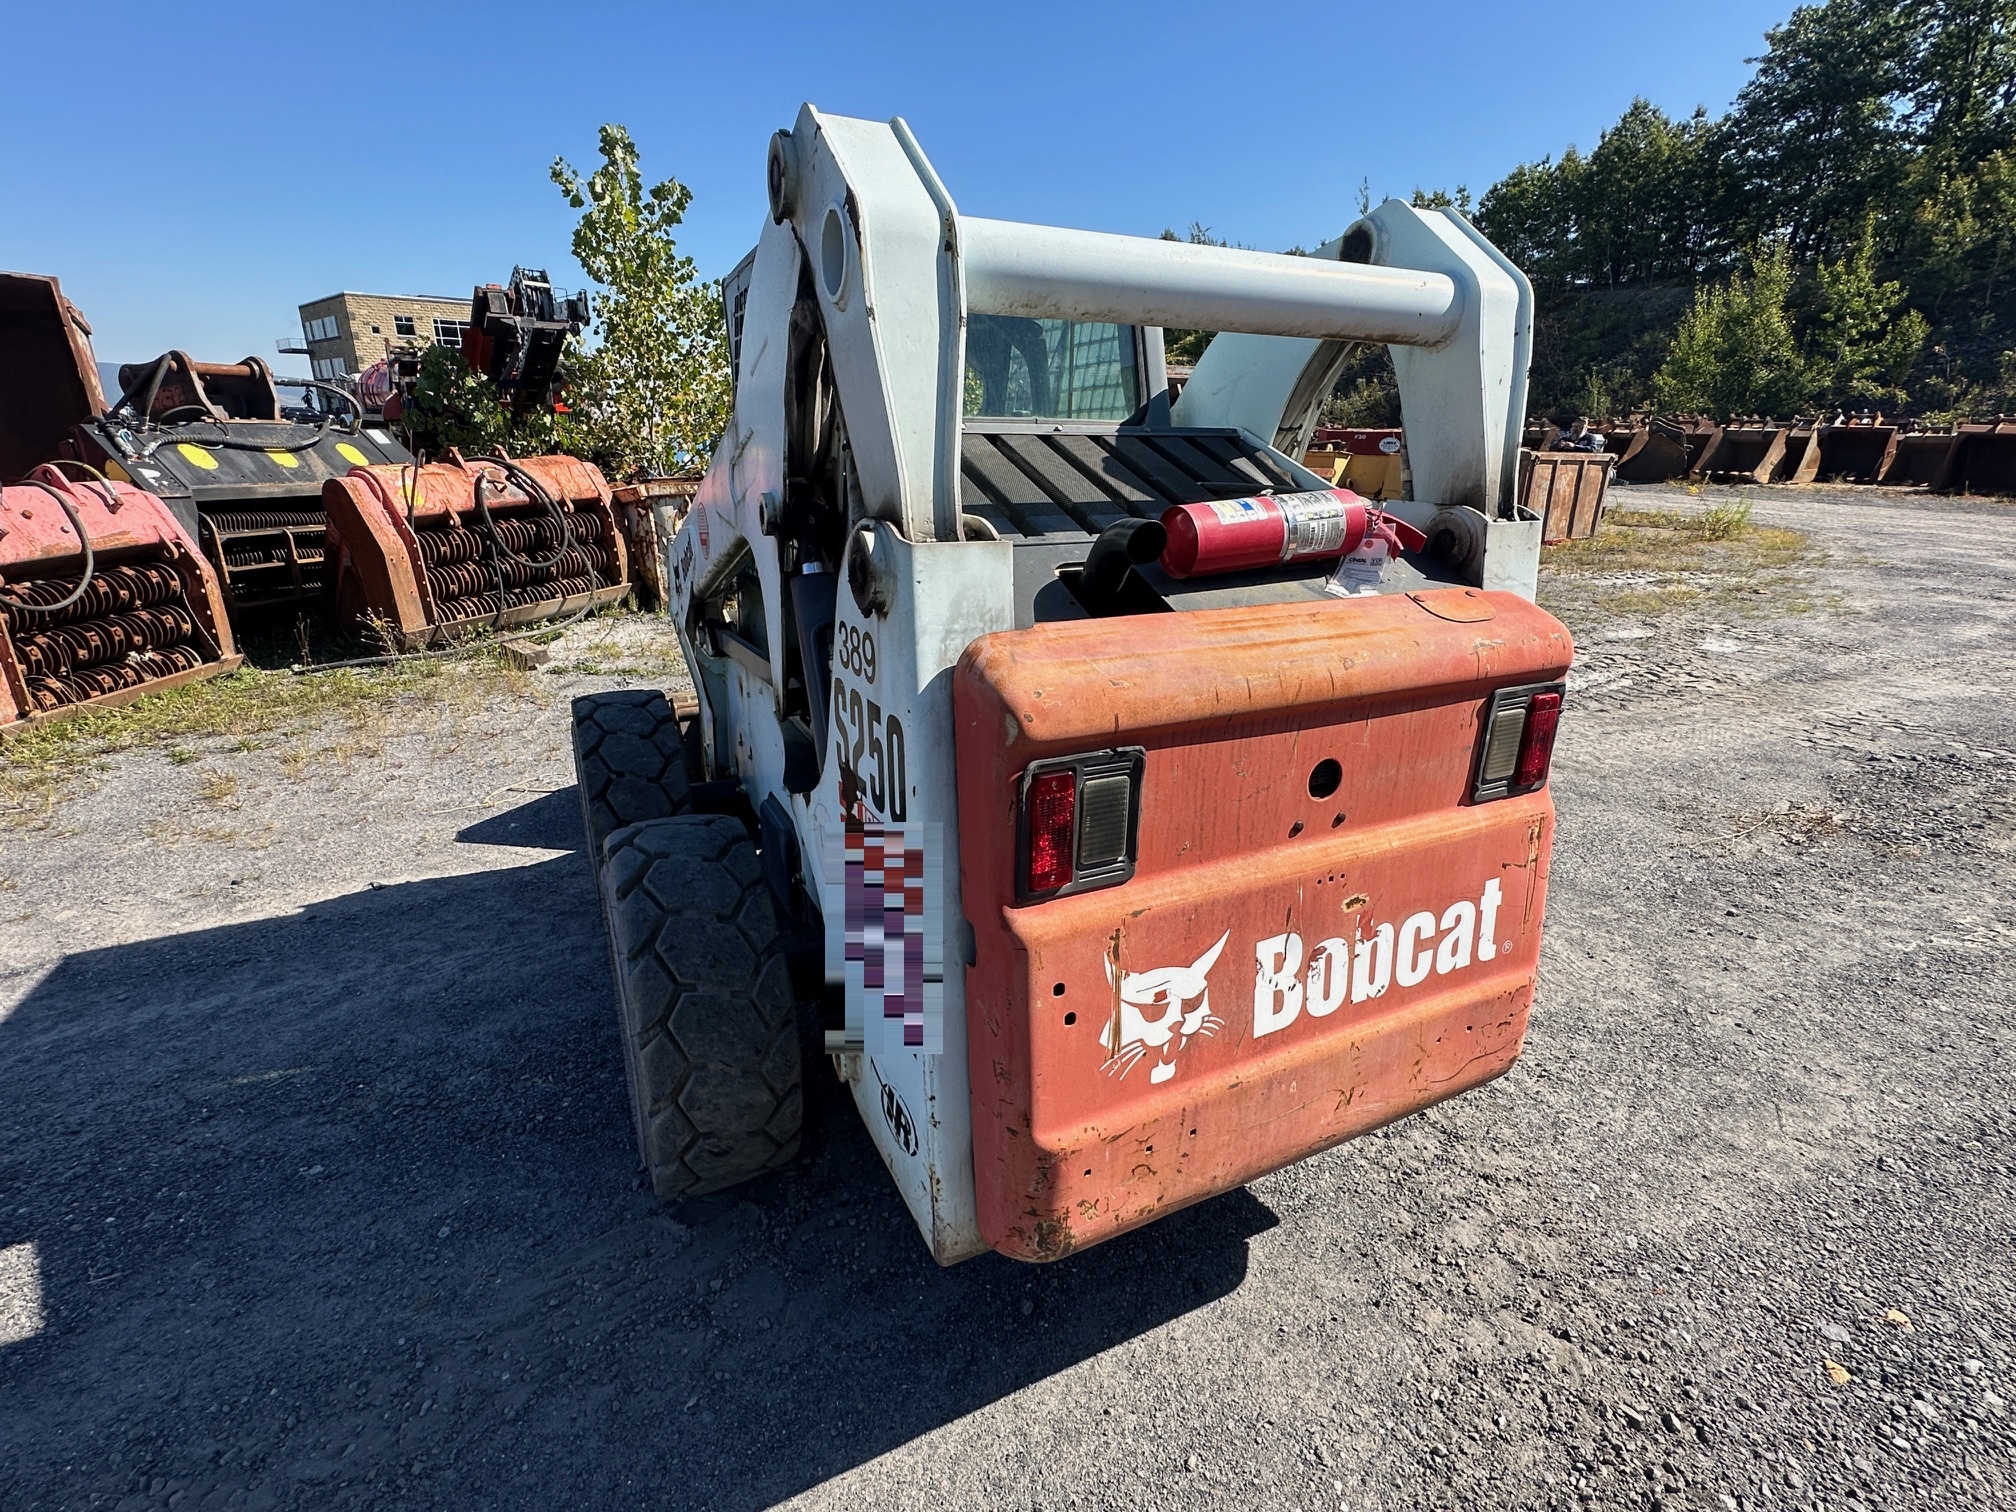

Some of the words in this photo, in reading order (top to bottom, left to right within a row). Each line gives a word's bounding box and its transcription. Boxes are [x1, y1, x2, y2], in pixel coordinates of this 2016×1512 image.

[838, 620, 876, 684] 389
[834, 677, 907, 822] S250
[1253, 877, 1502, 1038] Bobcat
